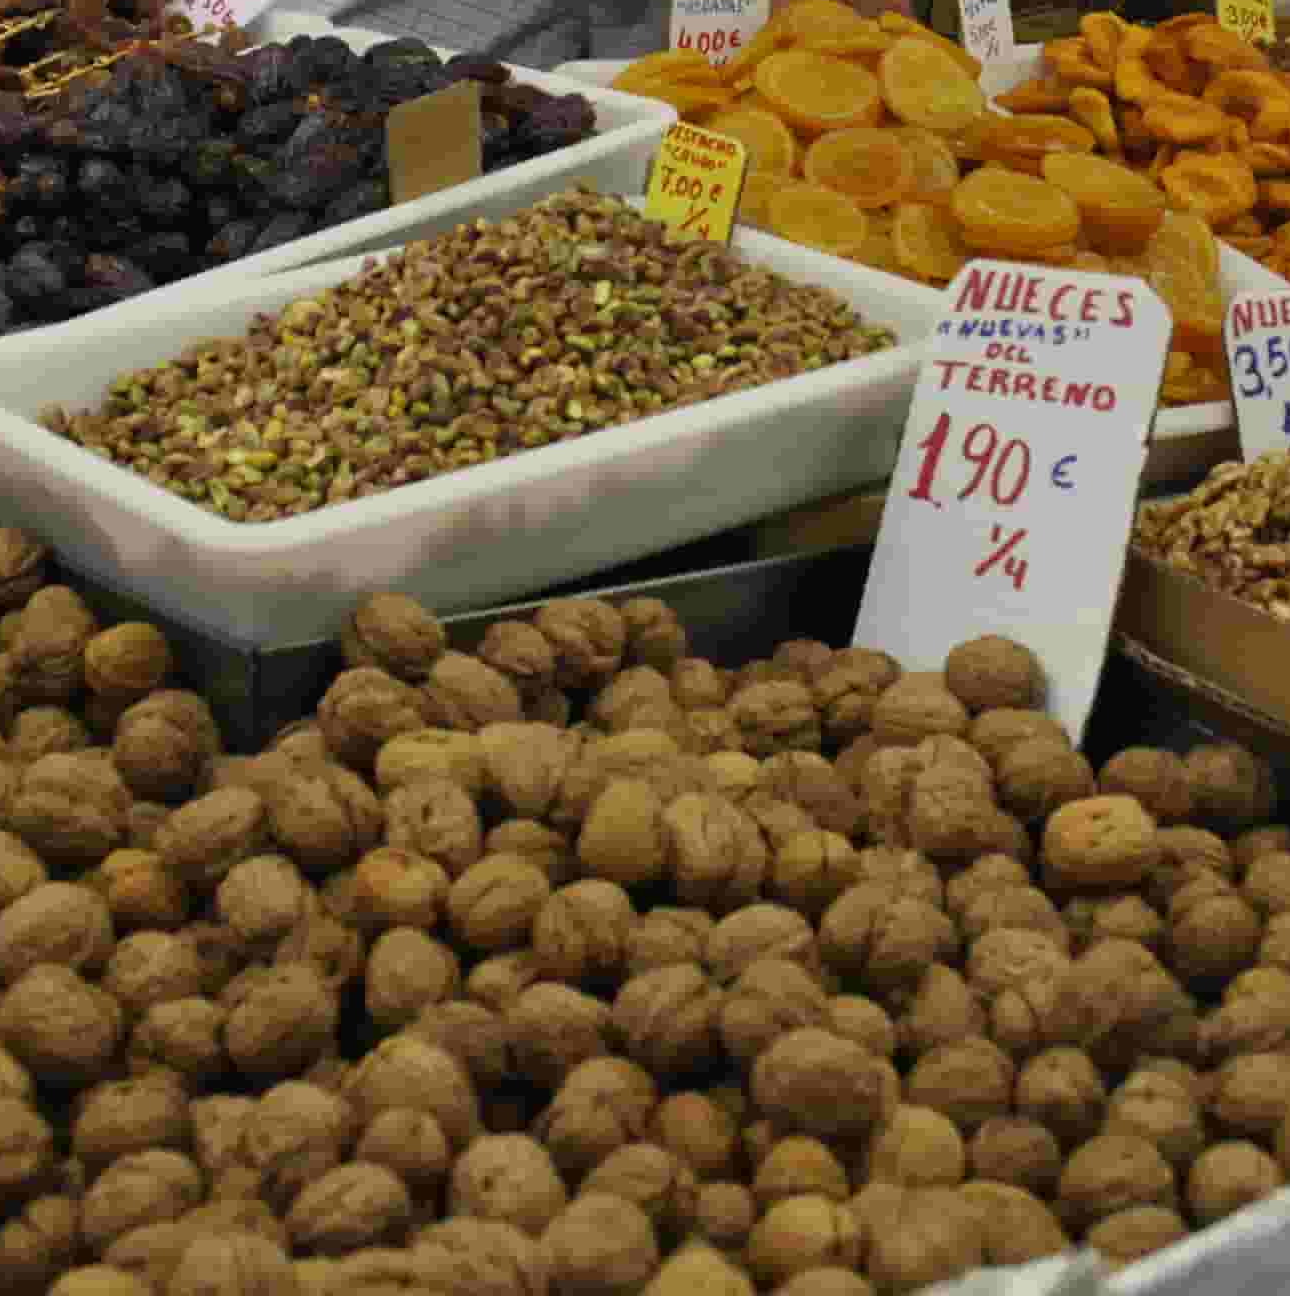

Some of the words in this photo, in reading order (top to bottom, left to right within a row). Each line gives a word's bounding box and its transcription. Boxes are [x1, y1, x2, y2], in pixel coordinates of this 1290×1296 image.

[955, 268, 1134, 328] NUECES
[984, 342, 1034, 364] DEL
[933, 359, 1117, 412] TERRENO
[1049, 453, 1079, 489] €
[973, 523, 1029, 591] 1/4
